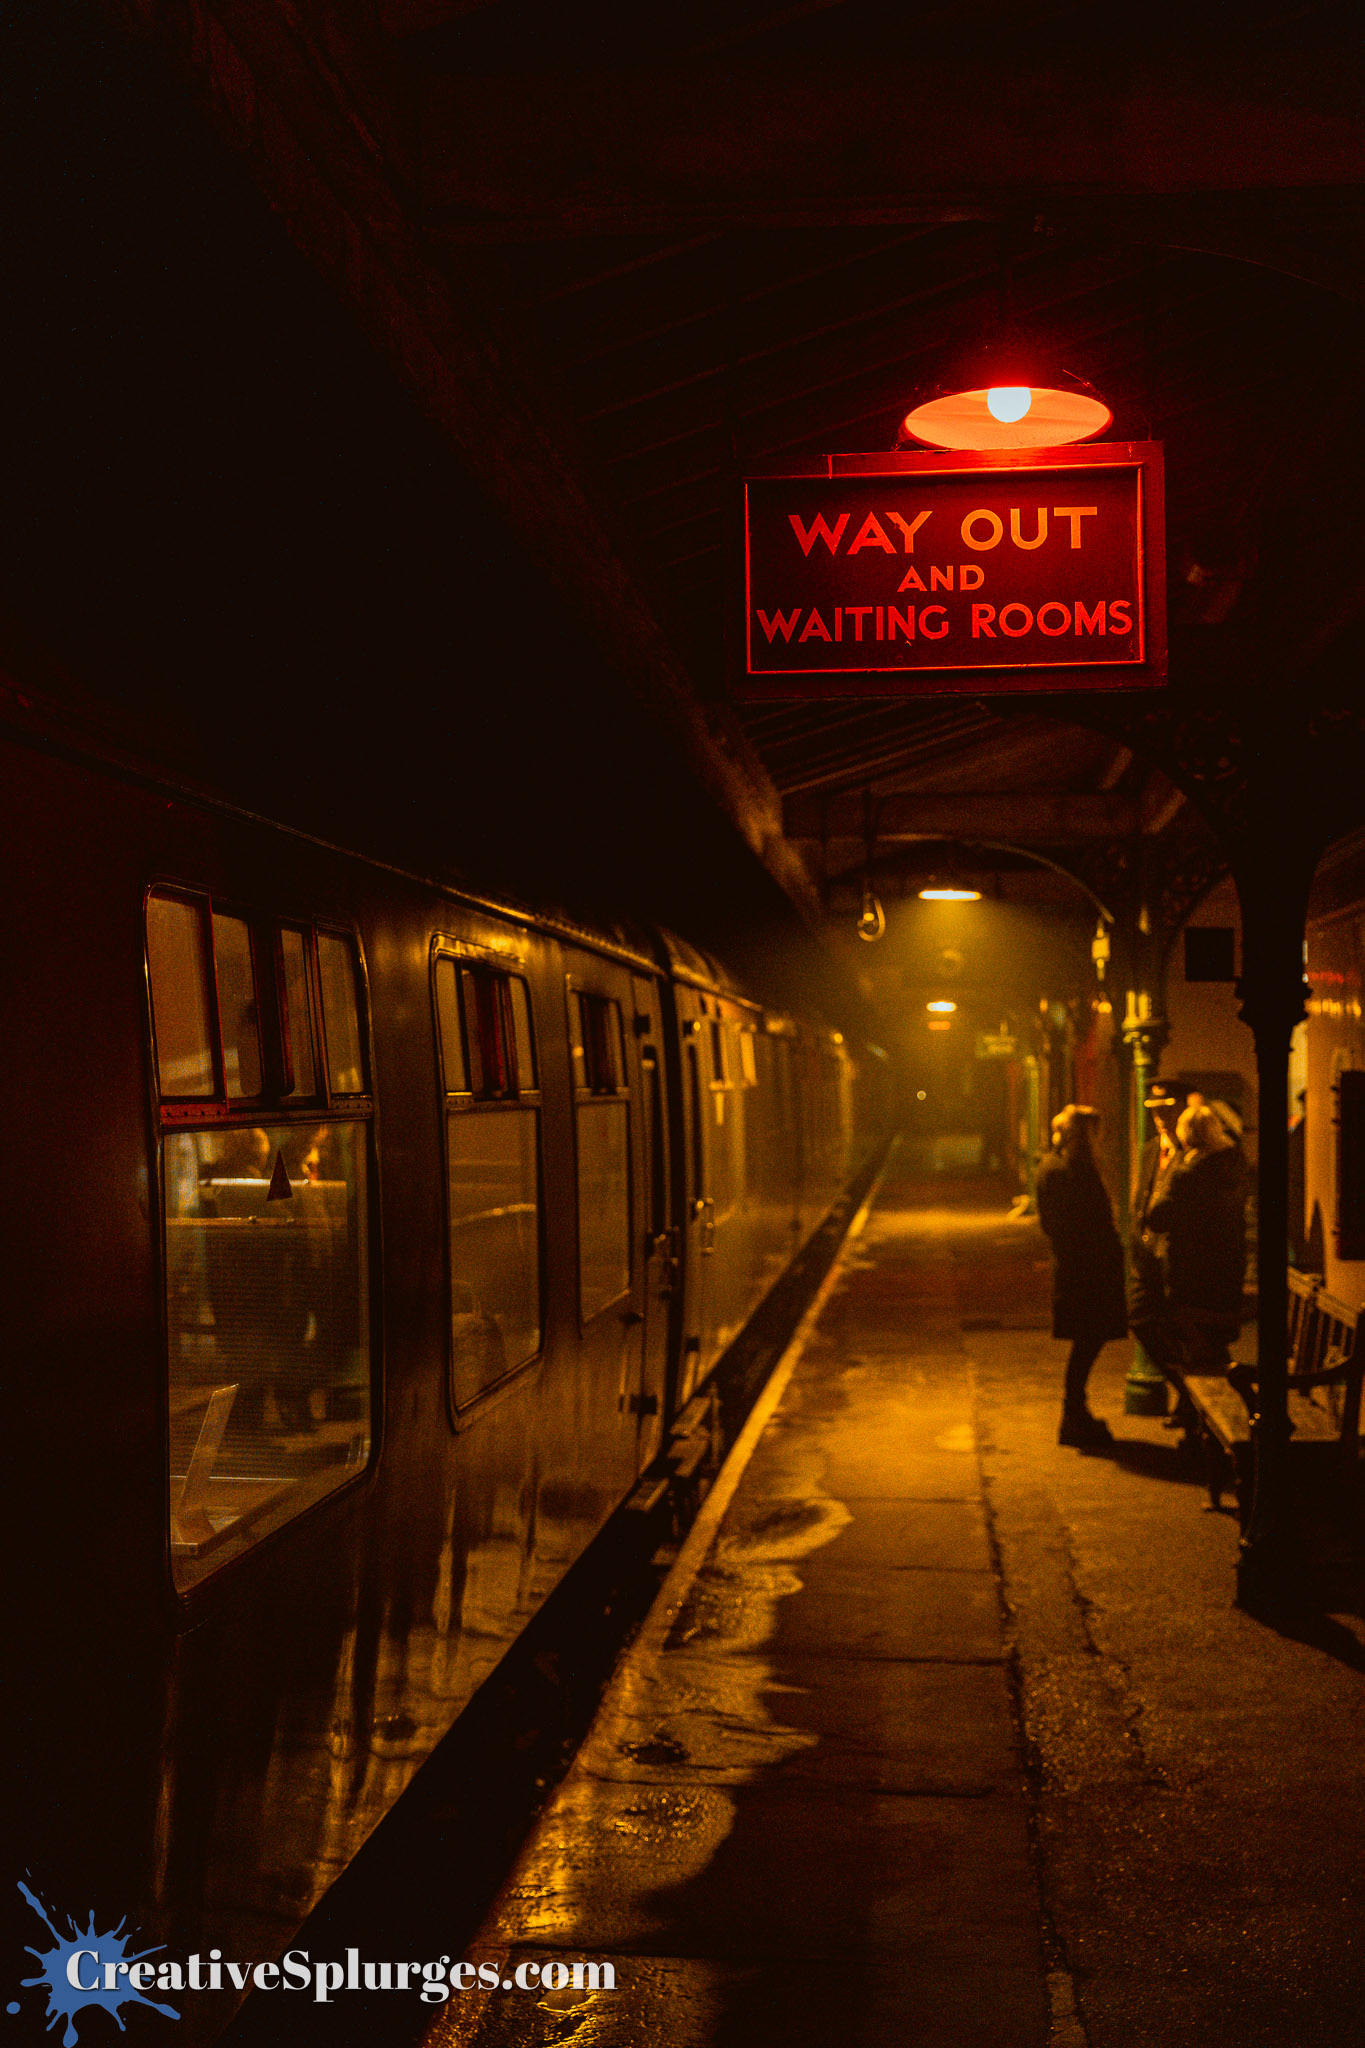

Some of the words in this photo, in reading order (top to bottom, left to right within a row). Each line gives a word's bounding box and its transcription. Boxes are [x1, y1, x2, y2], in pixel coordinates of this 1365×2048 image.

[787, 510, 933, 557] WAY
[960, 506, 1098, 551] OUT
[897, 564, 985, 593] AND
[756, 605, 949, 645] WAITING
[971, 600, 1133, 638] ROOMS
